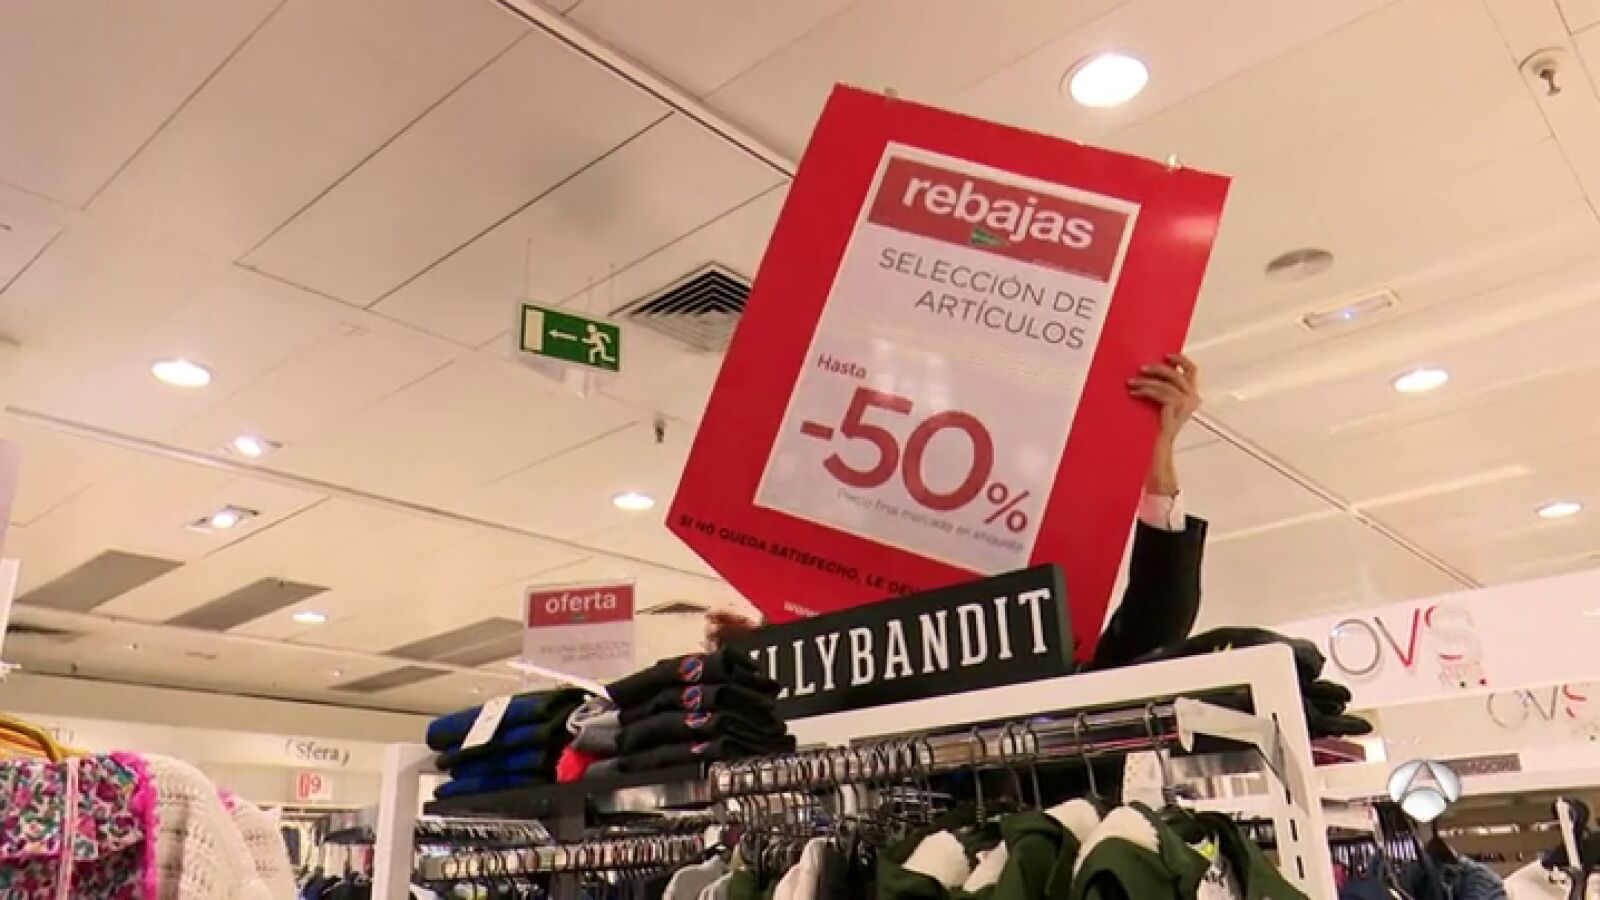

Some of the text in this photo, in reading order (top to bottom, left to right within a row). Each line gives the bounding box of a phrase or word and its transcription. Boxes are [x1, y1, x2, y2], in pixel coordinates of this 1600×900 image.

[902, 176, 1094, 249] rebajas
[879, 248, 1097, 320] SELECCIÓN DE
[915, 291, 1086, 350] ARTÍCULOS
[817, 353, 868, 381] Hasta
[679, 514, 693, 529] SI
[719, 527, 766, 552] QUEDA
[769, 544, 862, 584] SATISFECHO,
[866, 573, 883, 588] LE
[545, 592, 617, 614] oferta
